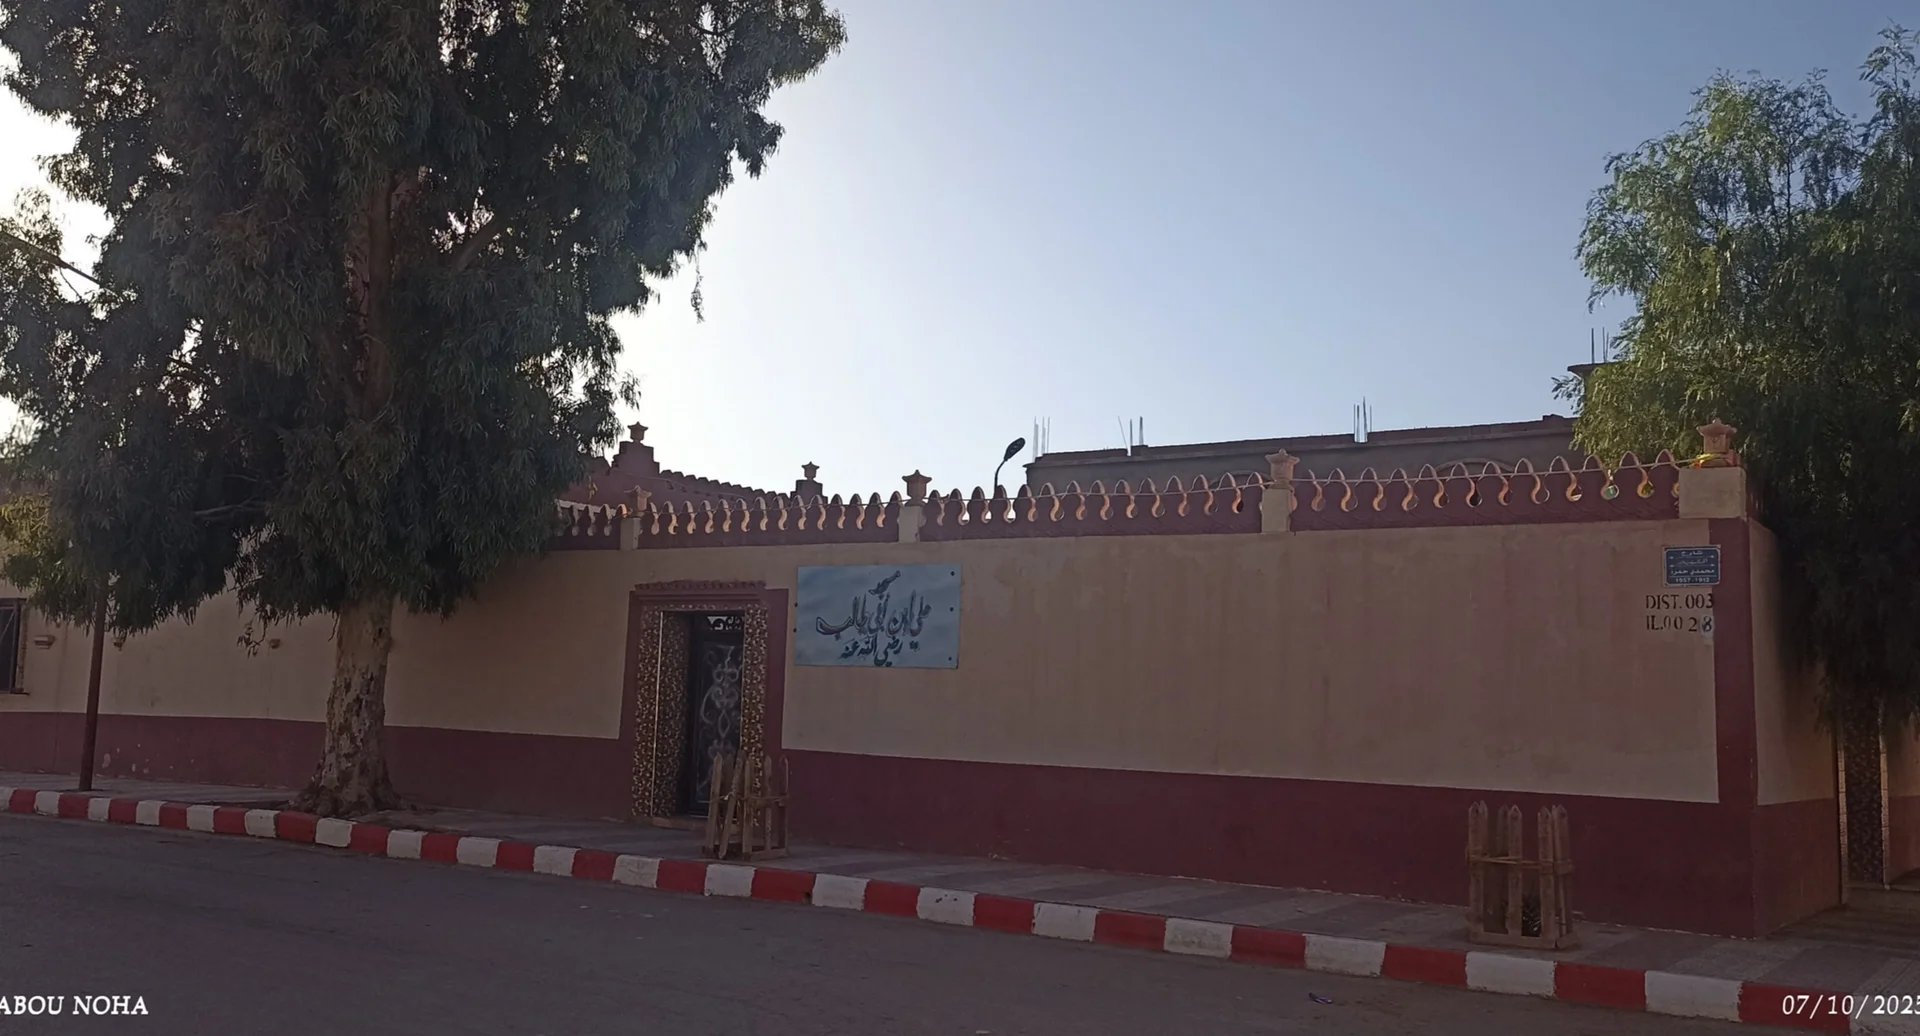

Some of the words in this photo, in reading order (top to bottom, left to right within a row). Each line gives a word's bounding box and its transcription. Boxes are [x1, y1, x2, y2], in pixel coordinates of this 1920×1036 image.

[1646, 594, 1682, 609] DIST.
[1685, 593, 1714, 609] 003
[816, 593, 872, 641] طالب
[838, 638, 860, 659] عنه
[857, 633, 878, 656] الله
[874, 636, 904, 667] رضي
